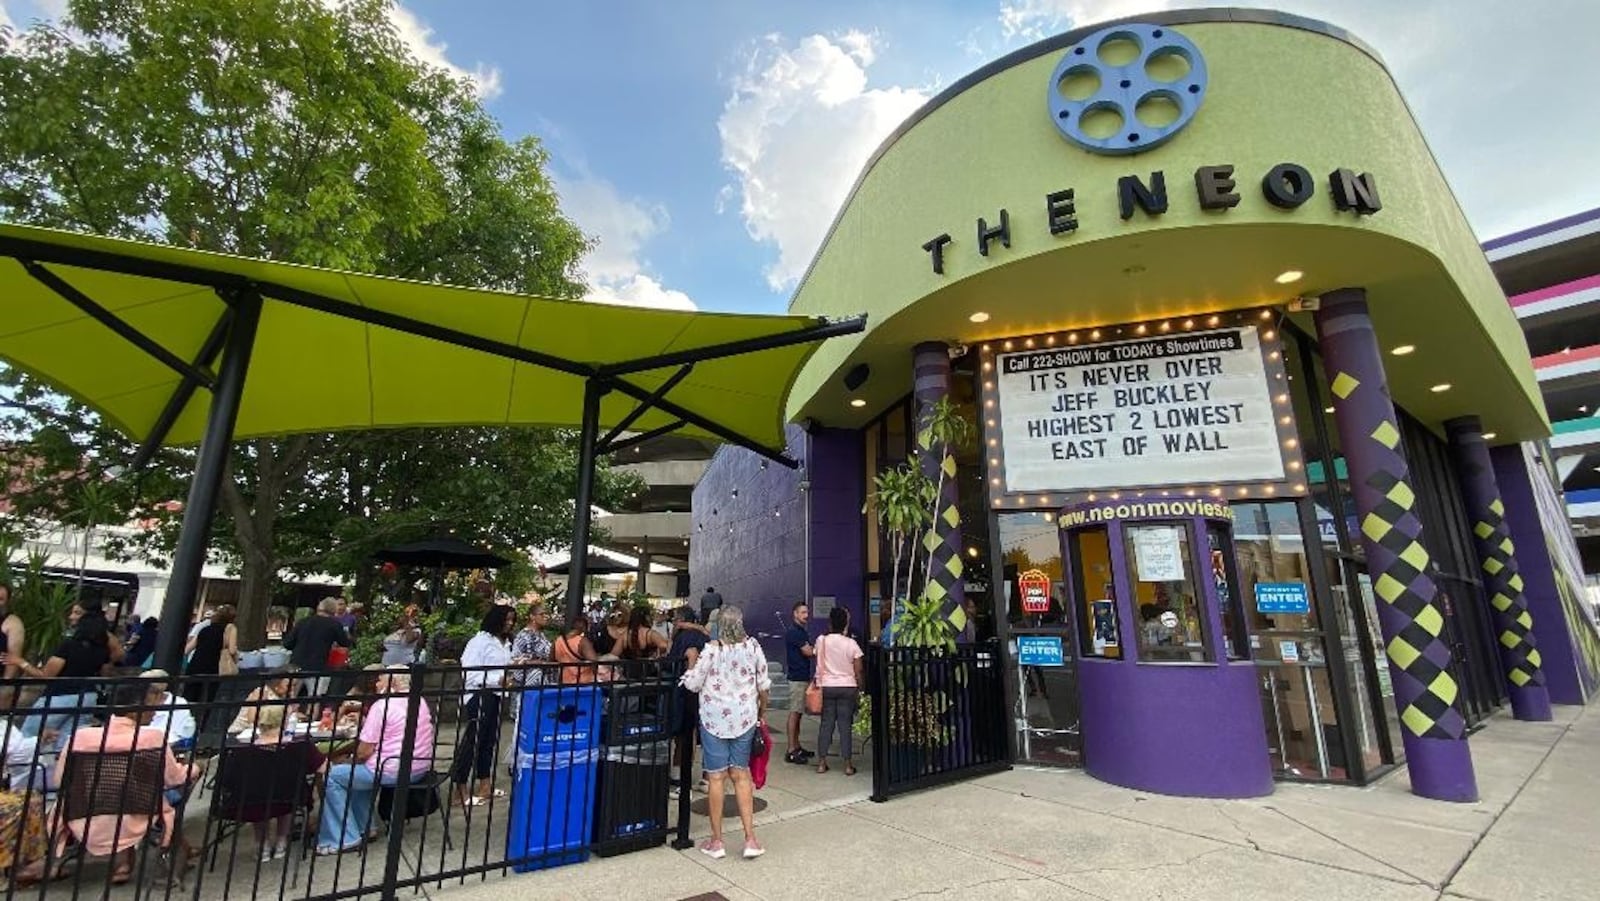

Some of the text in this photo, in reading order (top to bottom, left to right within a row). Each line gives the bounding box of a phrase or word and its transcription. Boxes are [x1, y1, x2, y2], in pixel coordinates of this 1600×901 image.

[922, 162, 1383, 275] THE NEON
[1009, 337, 1235, 371] Call 222-SHOW for TODAY's Showtimes
[1082, 364, 1150, 387] NEVER
[1165, 357, 1223, 379] OVER
[1051, 381, 1212, 412] JEFF BUCKLEY
[1028, 403, 1244, 438] HIGHEST 2 LOWEST
[1052, 431, 1229, 461] EAST OF WALL
[1259, 593, 1305, 603] ENTER
[1021, 645, 1059, 656] ENTER
